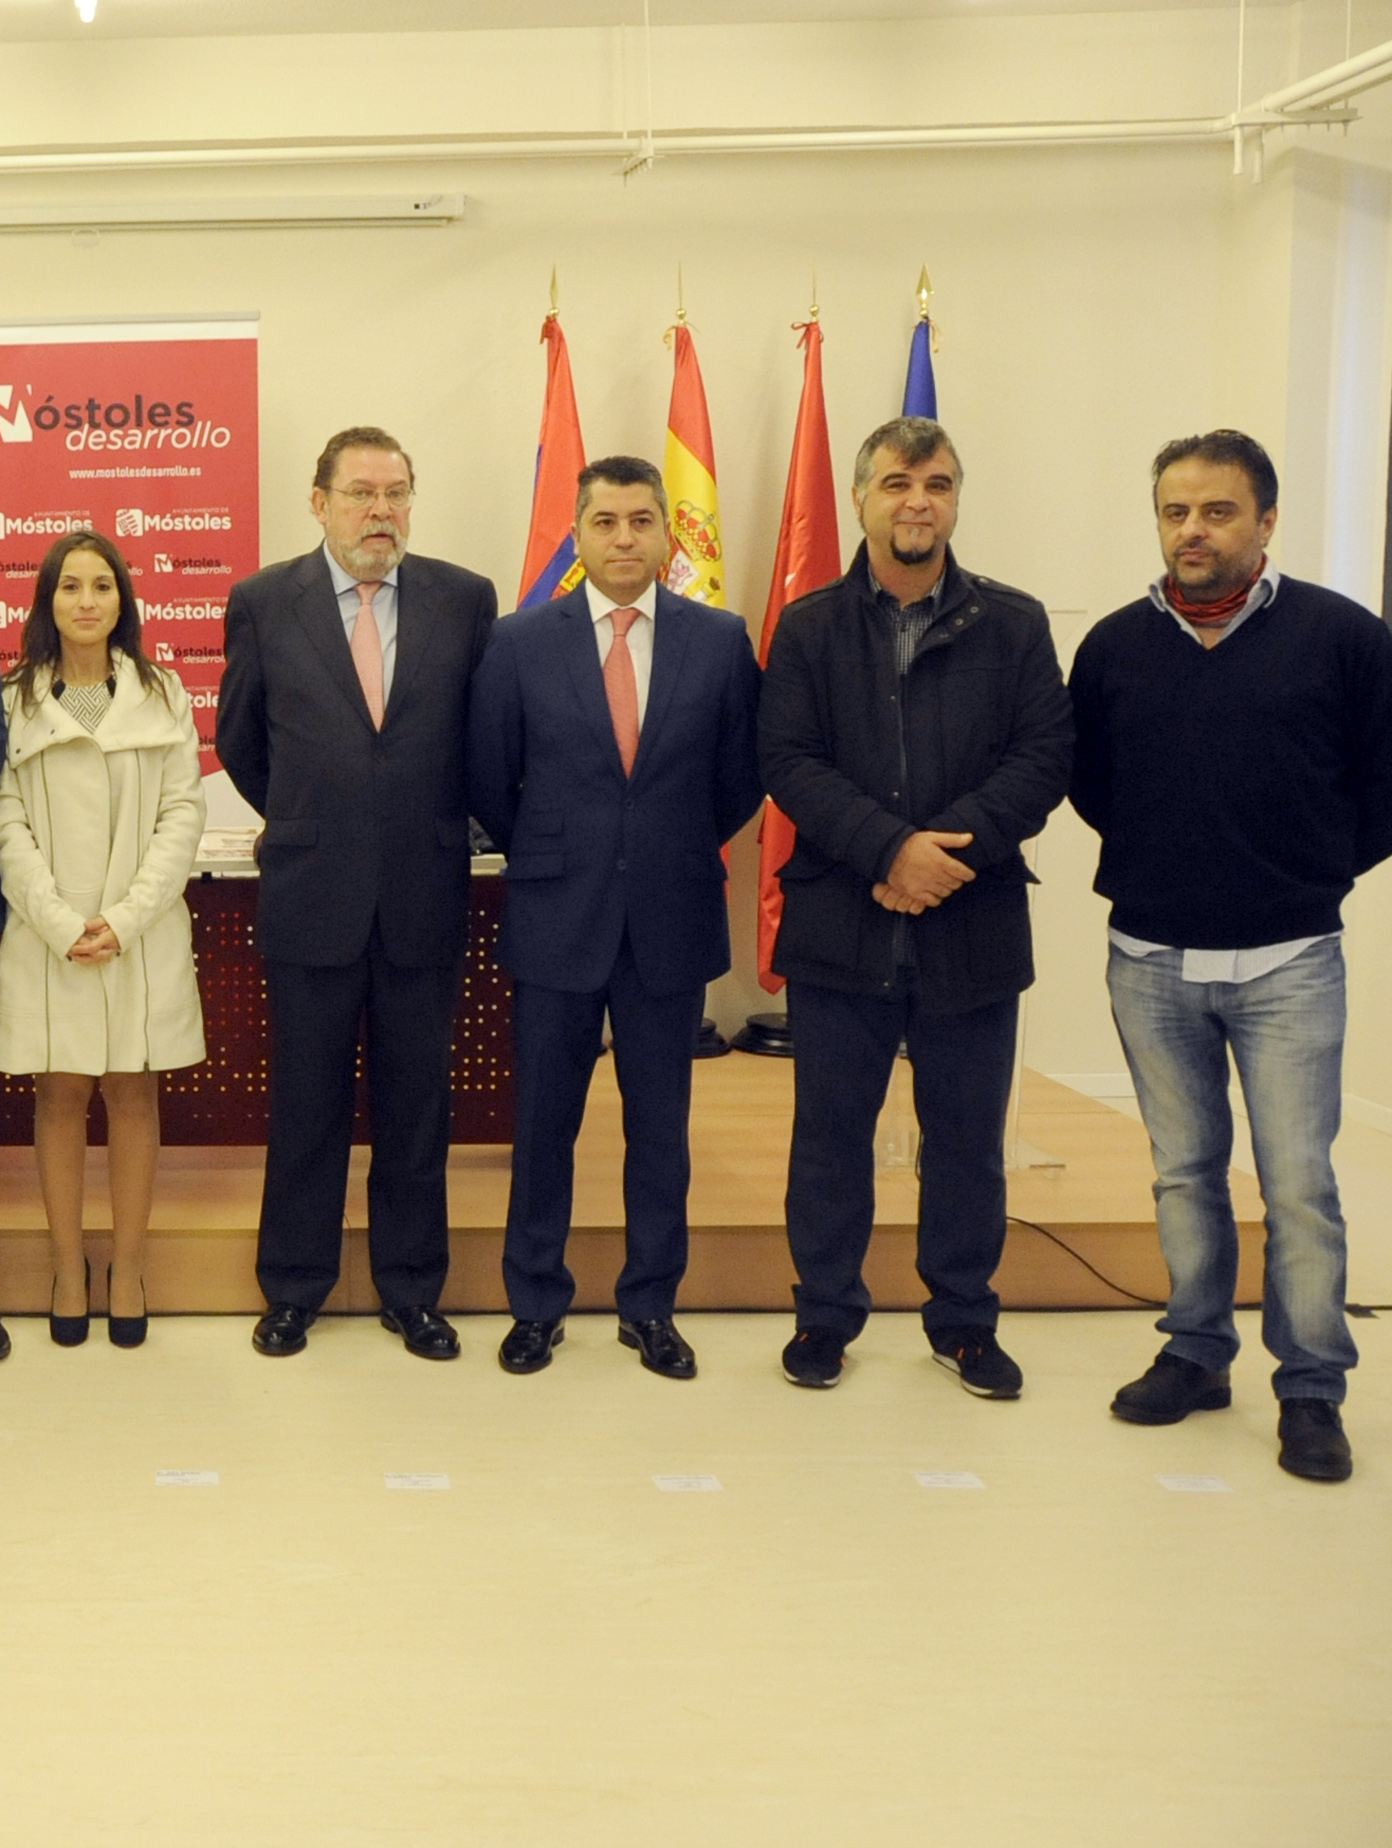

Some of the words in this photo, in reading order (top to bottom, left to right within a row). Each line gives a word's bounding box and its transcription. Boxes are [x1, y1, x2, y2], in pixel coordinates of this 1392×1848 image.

[65, 421, 231, 451] desarrollo
[68, 465, 202, 479] www.mostolesdesarrollo.es
[6, 516, 93, 534] Móstoles
[144, 513, 232, 531] Móstoles
